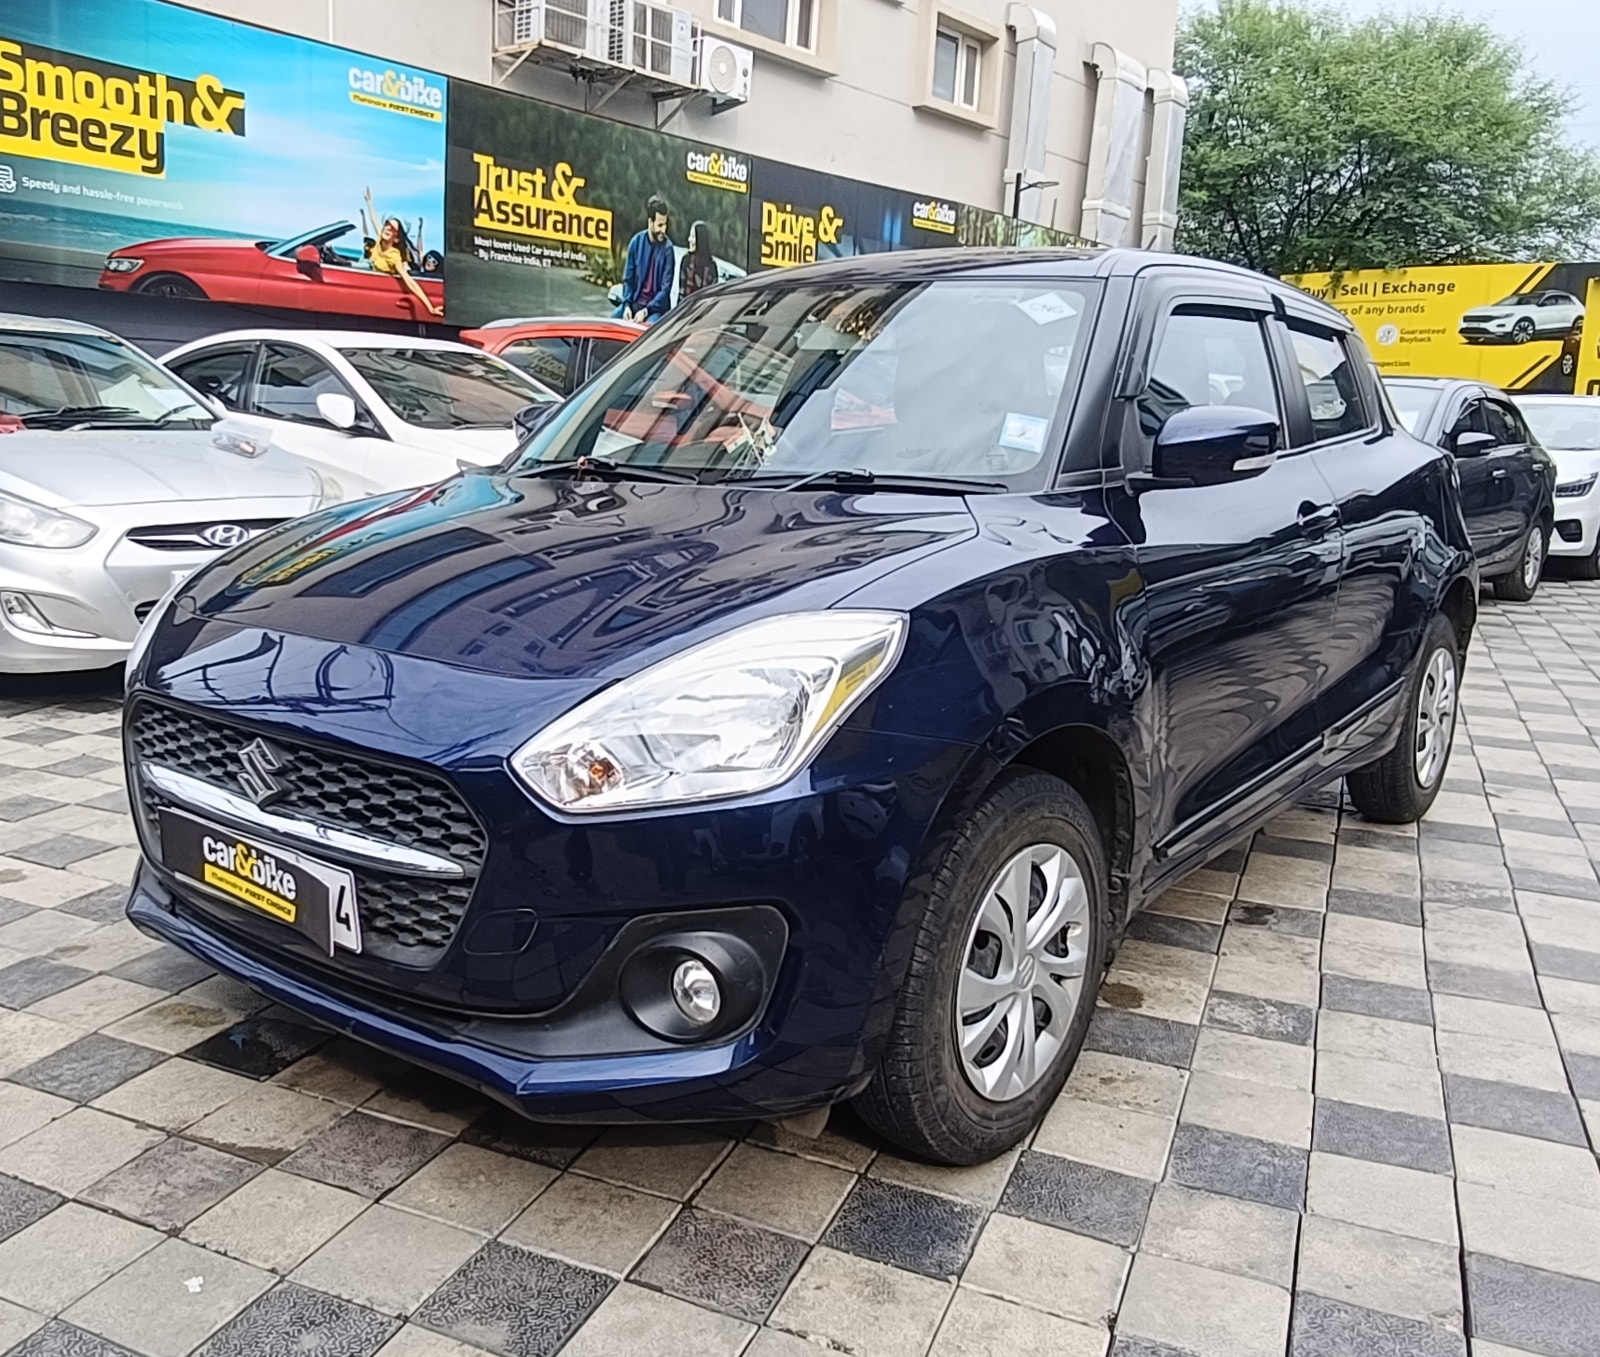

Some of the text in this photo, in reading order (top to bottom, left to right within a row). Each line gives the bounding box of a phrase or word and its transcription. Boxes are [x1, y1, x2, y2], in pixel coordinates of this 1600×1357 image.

[0, 39, 245, 135] Smooth &
[349, 68, 442, 109] car&bike
[0, 91, 165, 175] Breezy
[22, 177, 60, 193] Speedy
[62, 184, 81, 195] and
[82, 185, 135, 203] hassle-free
[473, 153, 585, 206] Trust &
[475, 188, 609, 241] Assurance
[762, 202, 843, 244] Drive &
[513, 243, 530, 253] Used
[761, 231, 813, 264] Smile
[1029, 302, 1064, 314] CNG
[1341, 283, 1368, 296] Sell
[1382, 280, 1456, 295] Exchange
[1351, 304, 1363, 315] of
[1365, 306, 1384, 317] any
[1387, 303, 1425, 314] brands
[1399, 336, 1431, 344] Buyback
[203, 836, 296, 900] car&bike
[336, 885, 351, 932] 4
